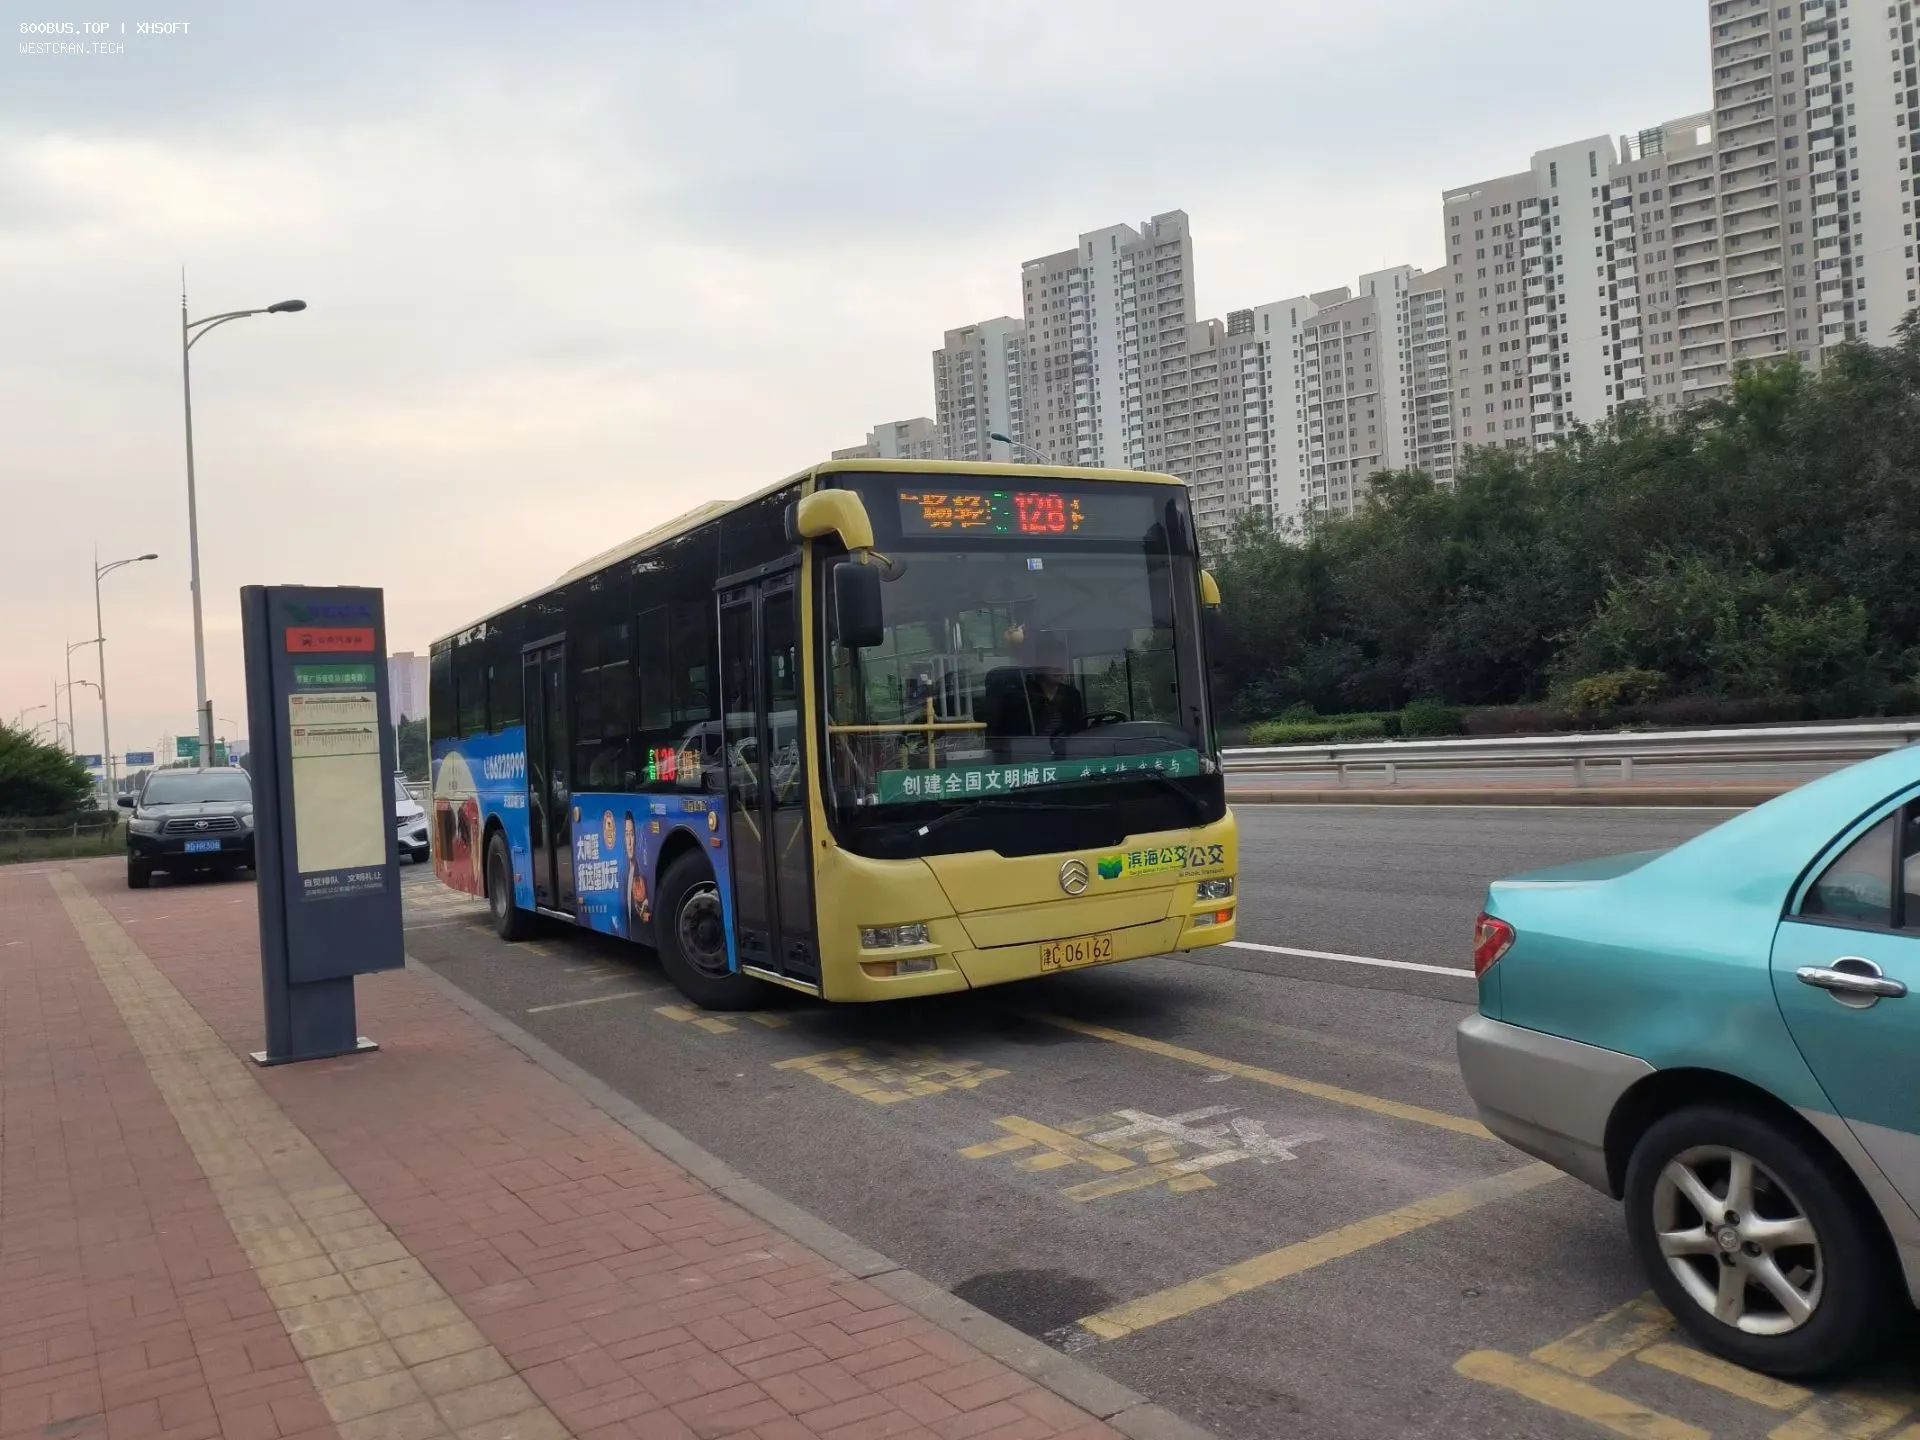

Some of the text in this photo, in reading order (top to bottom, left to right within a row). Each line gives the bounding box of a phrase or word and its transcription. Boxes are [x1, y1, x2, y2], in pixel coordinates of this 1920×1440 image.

[1015, 493, 1066, 533] 128
[902, 767, 1057, 795] 创建全国文明城区
[1128, 848, 1186, 868] 滨海公交
